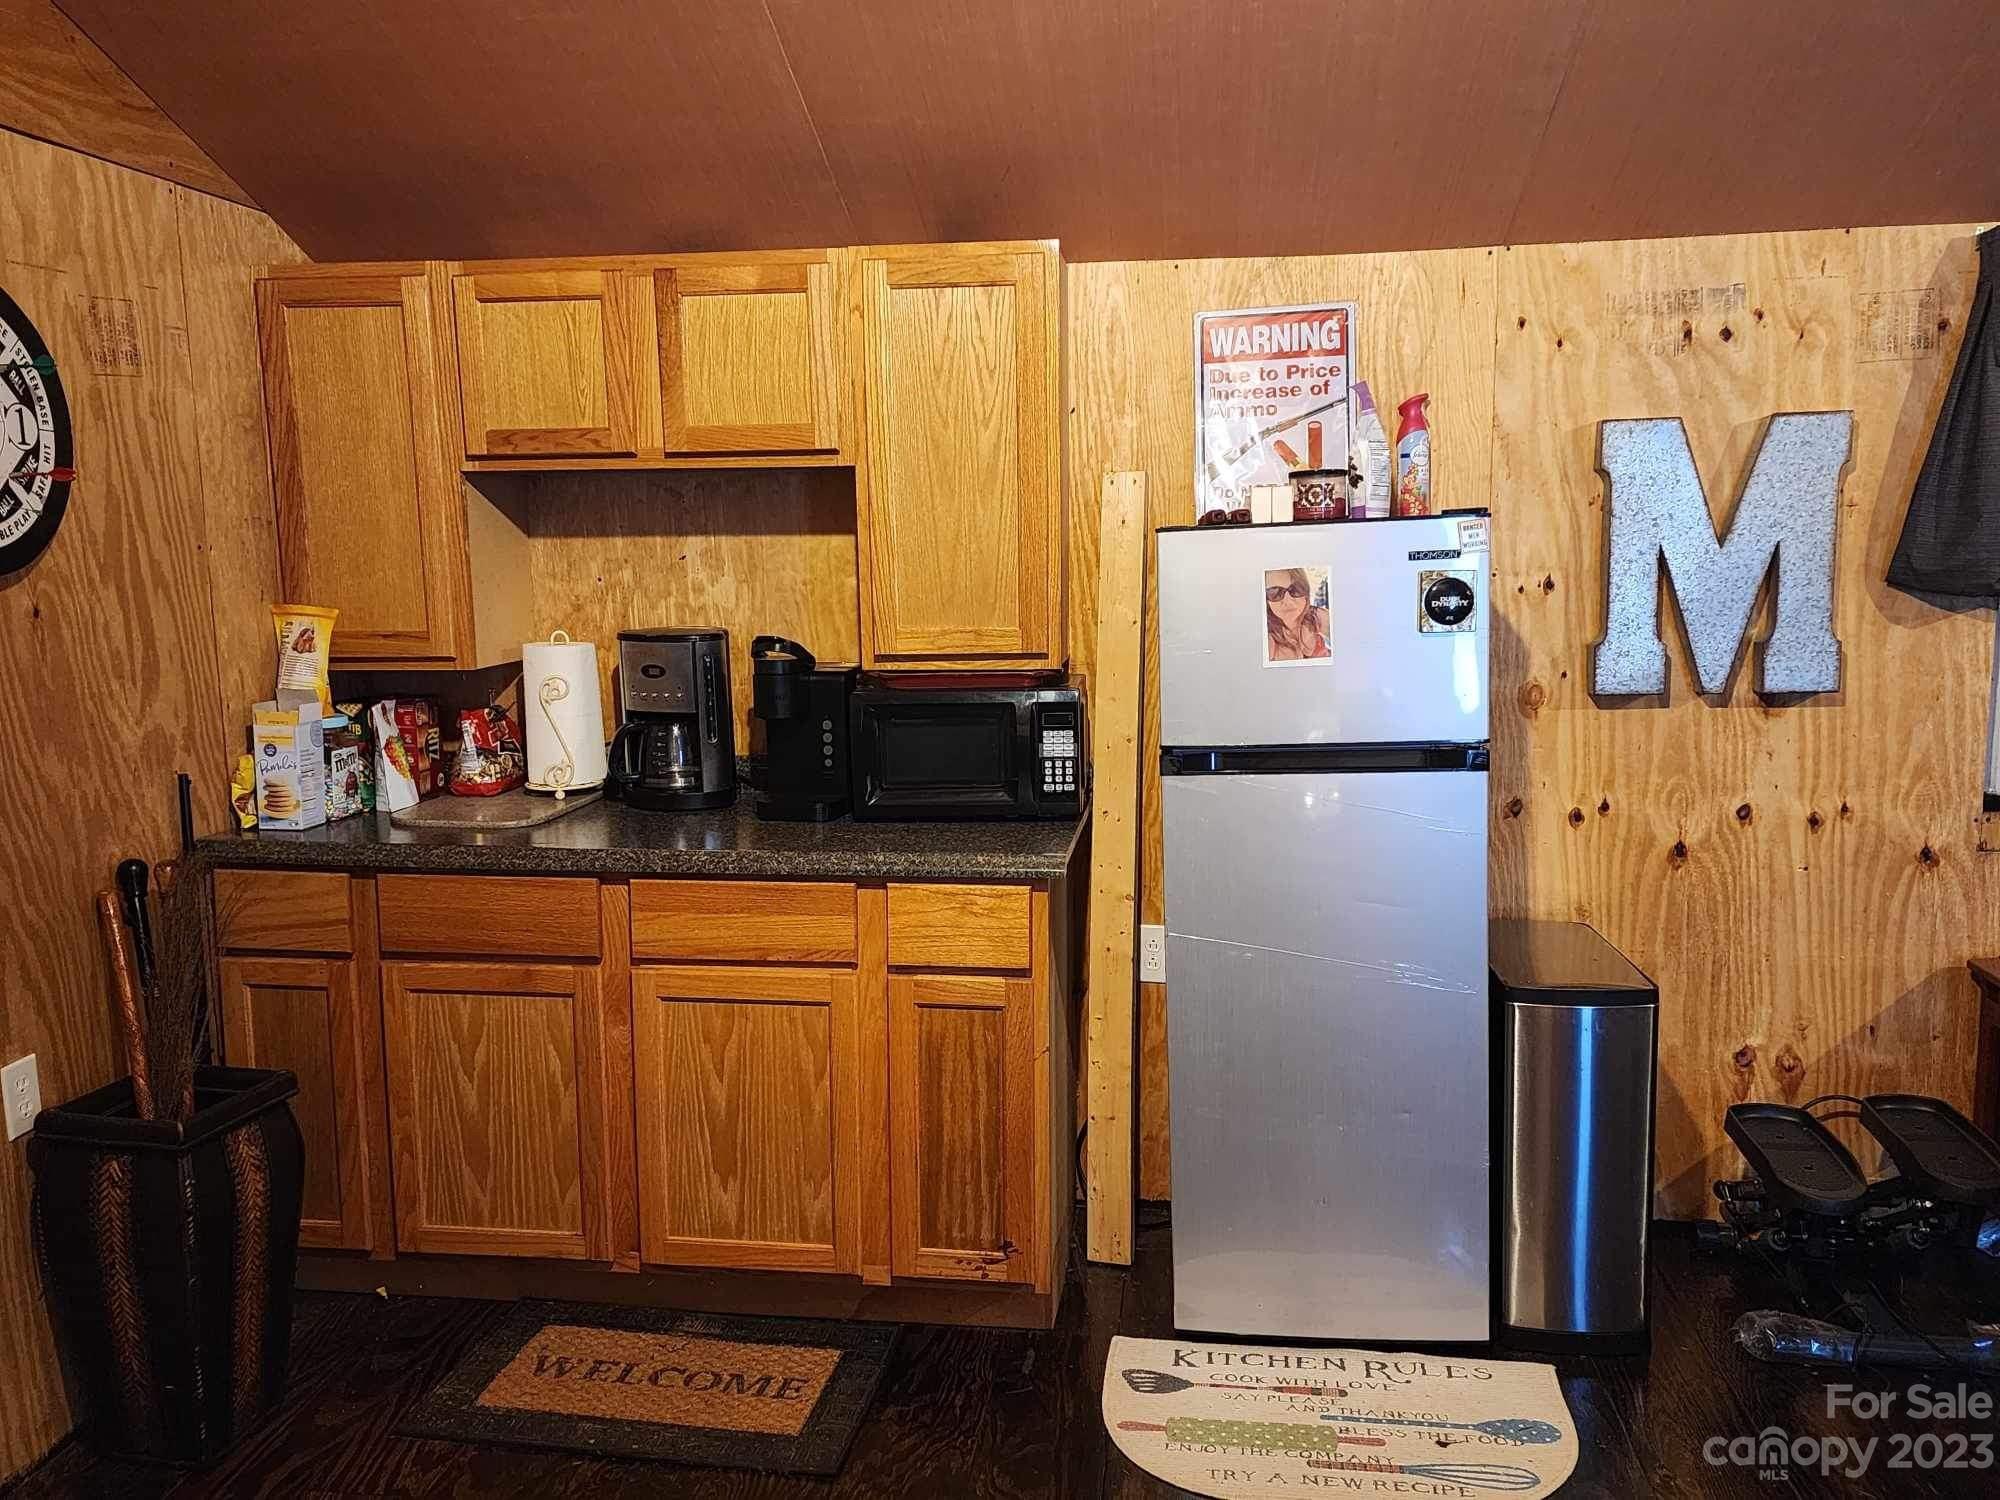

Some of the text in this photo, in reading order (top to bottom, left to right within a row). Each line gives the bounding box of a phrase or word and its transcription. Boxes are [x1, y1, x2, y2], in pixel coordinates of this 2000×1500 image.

[1209, 319, 1341, 358] WARNING
[9, 369, 26, 396] BALL
[1209, 362, 1341, 385] Due to Price
[15, 348, 49, 426] STOLEN BASE
[1209, 379, 1331, 401] Increase of
[1209, 403, 1278, 419] Ammo
[15, 407, 31, 446] 1
[36, 472, 49, 500] SAFE
[14, 509, 31, 532] PLAY
[1409, 550, 1458, 560] THOMSON
[1592, 409, 1854, 697] M
[428, 727, 440, 763] RITZ
[530, 1347, 809, 1401] WELCOME
[1172, 1349, 1493, 1384] KITCHEN RULES
[1209, 1373, 1397, 1392] COOK WITH LOVE
[1220, 1391, 1342, 1407] SAY PLEASE
[1287, 1404, 1331, 1413] AND
[1338, 1425, 1525, 1447] BLESS THE FOOD
[1164, 1441, 1396, 1466] ENJOY THE COMPANY
[1205, 1468, 1477, 1498] TRY A NEW RECIPE
